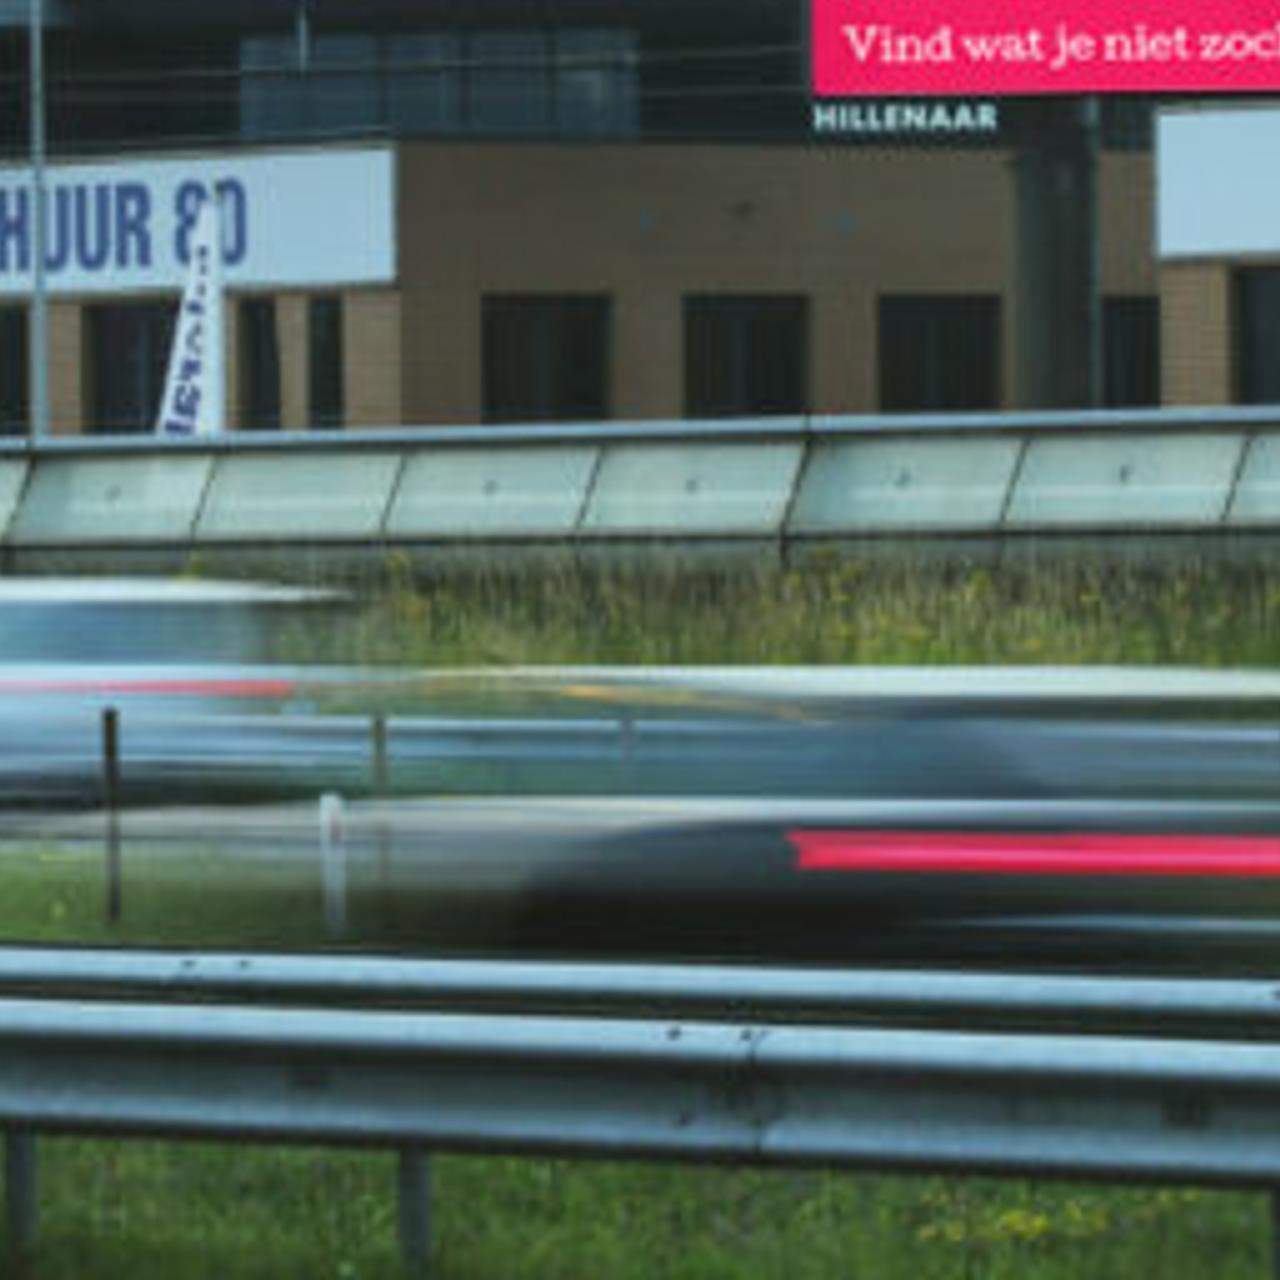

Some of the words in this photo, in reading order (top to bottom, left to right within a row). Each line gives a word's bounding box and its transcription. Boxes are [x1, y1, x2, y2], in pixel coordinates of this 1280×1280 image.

[843, 24, 952, 63] Vind
[961, 30, 1044, 63] wat
[1049, 24, 1097, 71] je
[1103, 24, 1190, 62] niet
[814, 103, 996, 133] HILLENAAR
